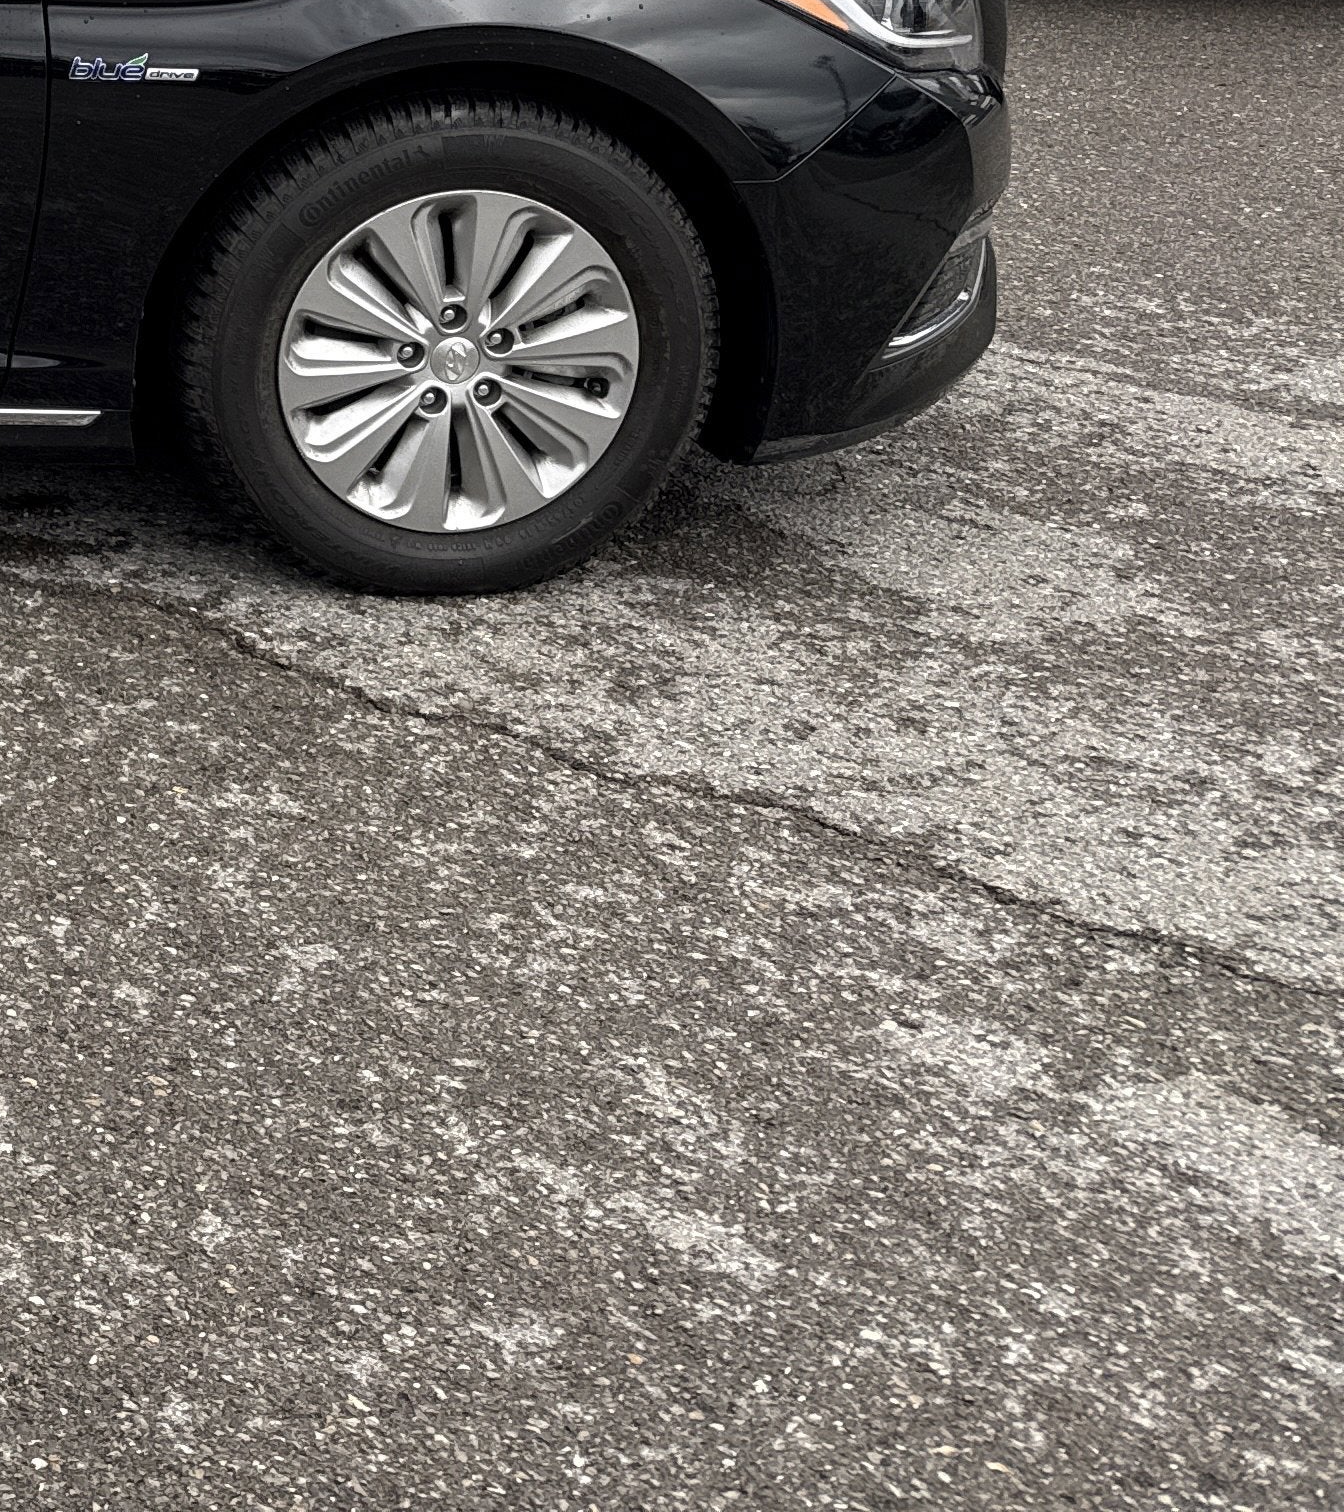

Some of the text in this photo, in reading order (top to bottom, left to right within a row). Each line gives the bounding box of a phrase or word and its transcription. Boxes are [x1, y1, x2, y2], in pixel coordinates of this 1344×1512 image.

[69, 55, 196, 81] blue drive
[298, 149, 411, 229] Continental
